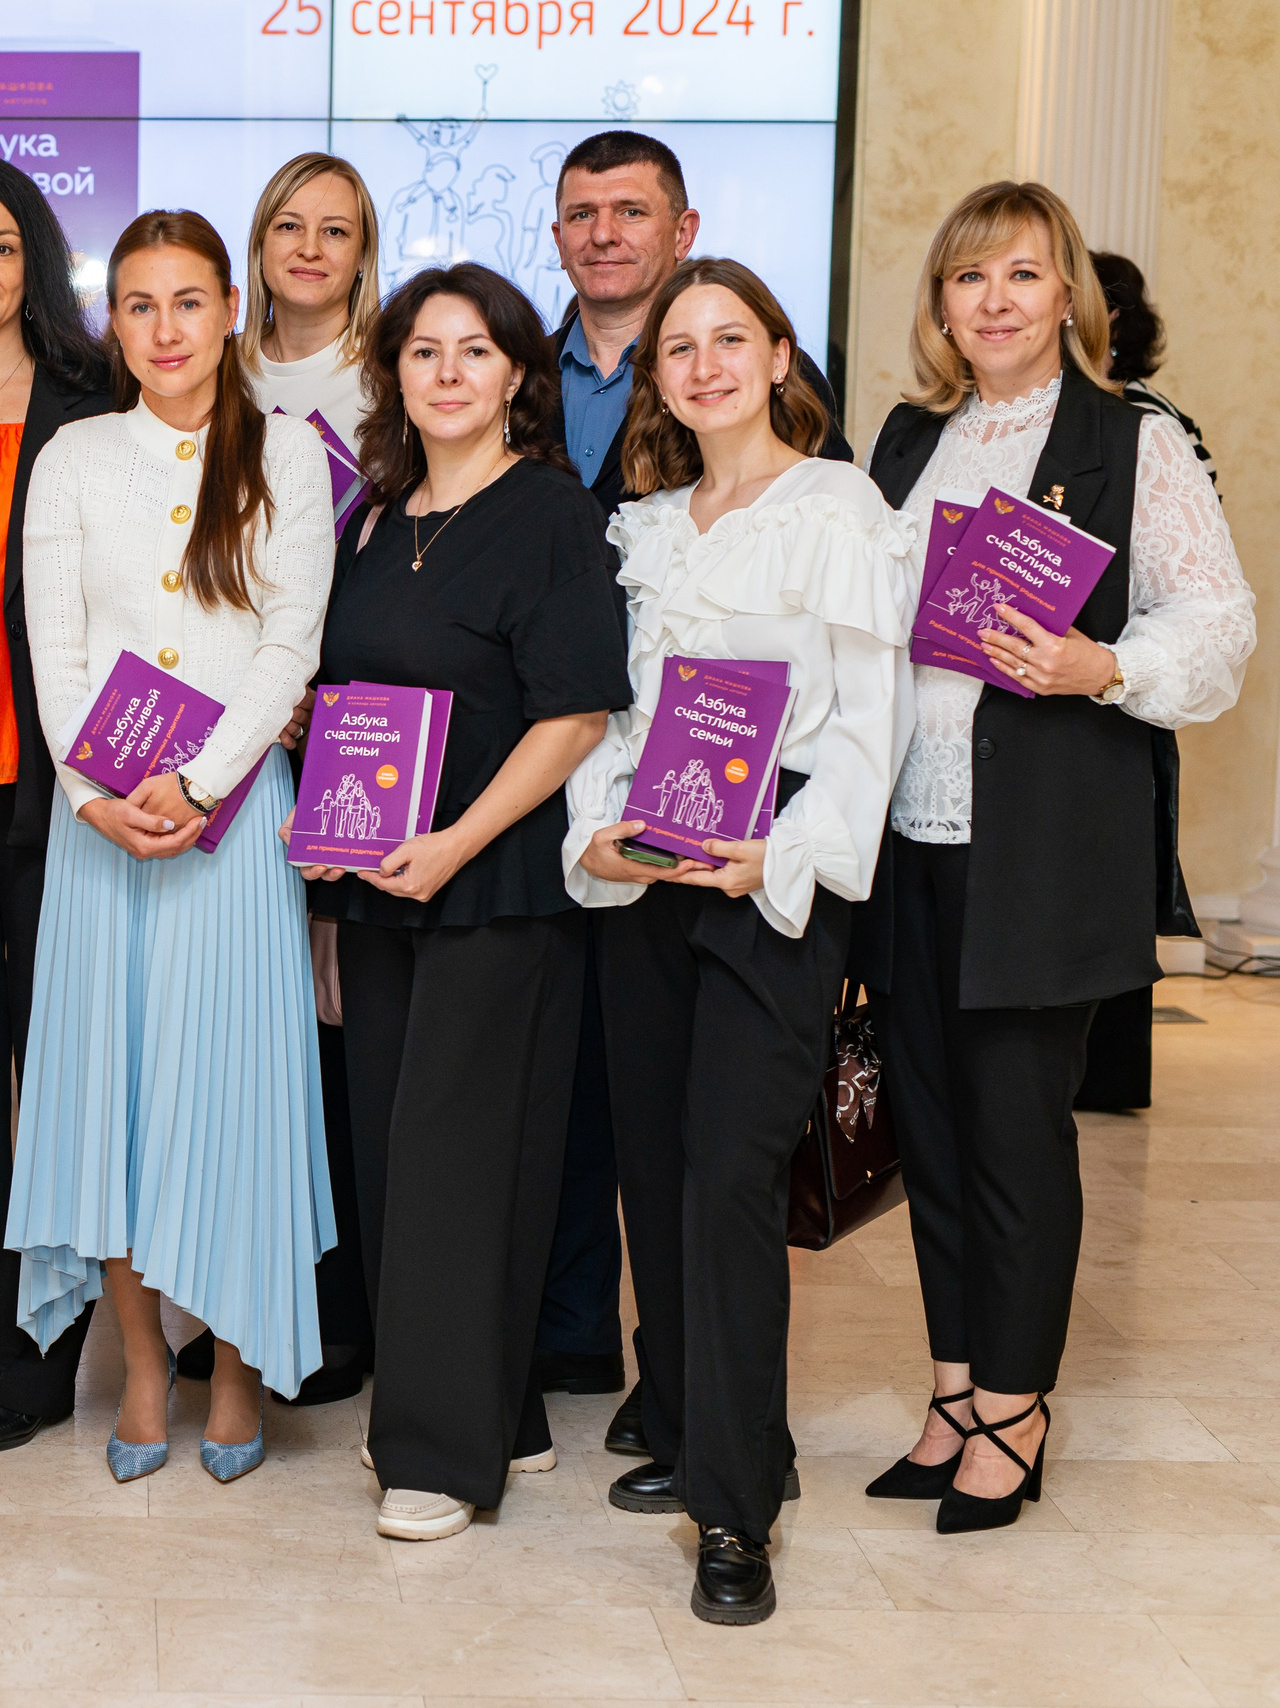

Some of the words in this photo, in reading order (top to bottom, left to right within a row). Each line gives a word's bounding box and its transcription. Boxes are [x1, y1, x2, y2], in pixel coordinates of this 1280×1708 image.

[261, 0, 322, 35] 25
[351, 0, 594, 50] сентября
[623, 0, 755, 36] 2024
[783, 2, 814, 36] г.
[985, 534, 1072, 588] счастливой
[1008, 528, 1063, 567] Азбука
[999, 557, 1045, 589] семьи
[106, 696, 142, 749] Азбука
[166, 703, 186, 739] родителей
[340, 712, 388, 729] Азбука
[674, 706, 758, 739] счастливой
[693, 692, 747, 719] Азбука
[113, 688, 162, 769] счастливой
[136, 714, 165, 758] семьи
[324, 729, 401, 743] счастливой
[689, 727, 734, 748] семьи
[339, 745, 380, 757] семьи
